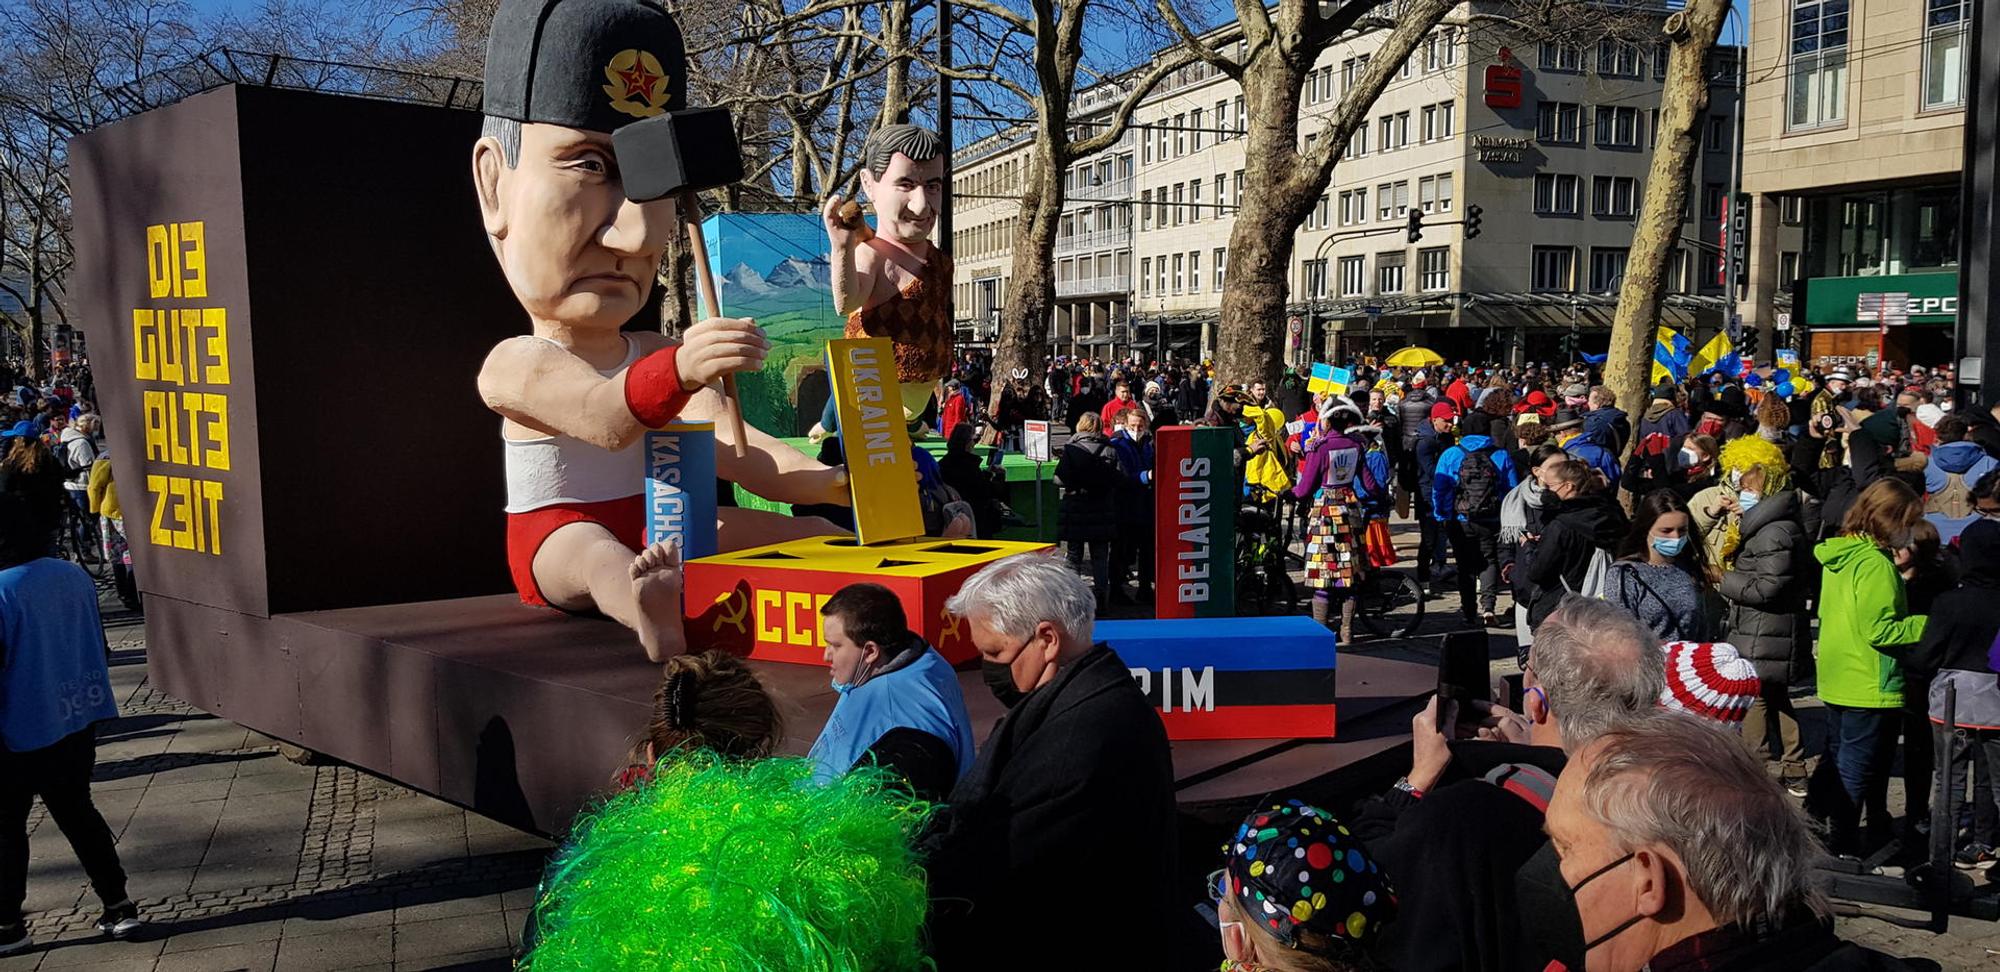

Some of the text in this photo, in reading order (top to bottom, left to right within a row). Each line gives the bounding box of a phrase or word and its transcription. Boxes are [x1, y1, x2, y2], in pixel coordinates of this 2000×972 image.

[1734, 200, 1747, 275] DEPOT
[849, 348, 896, 467] UKRAINE
[1178, 457, 1211, 603] BELARUS
